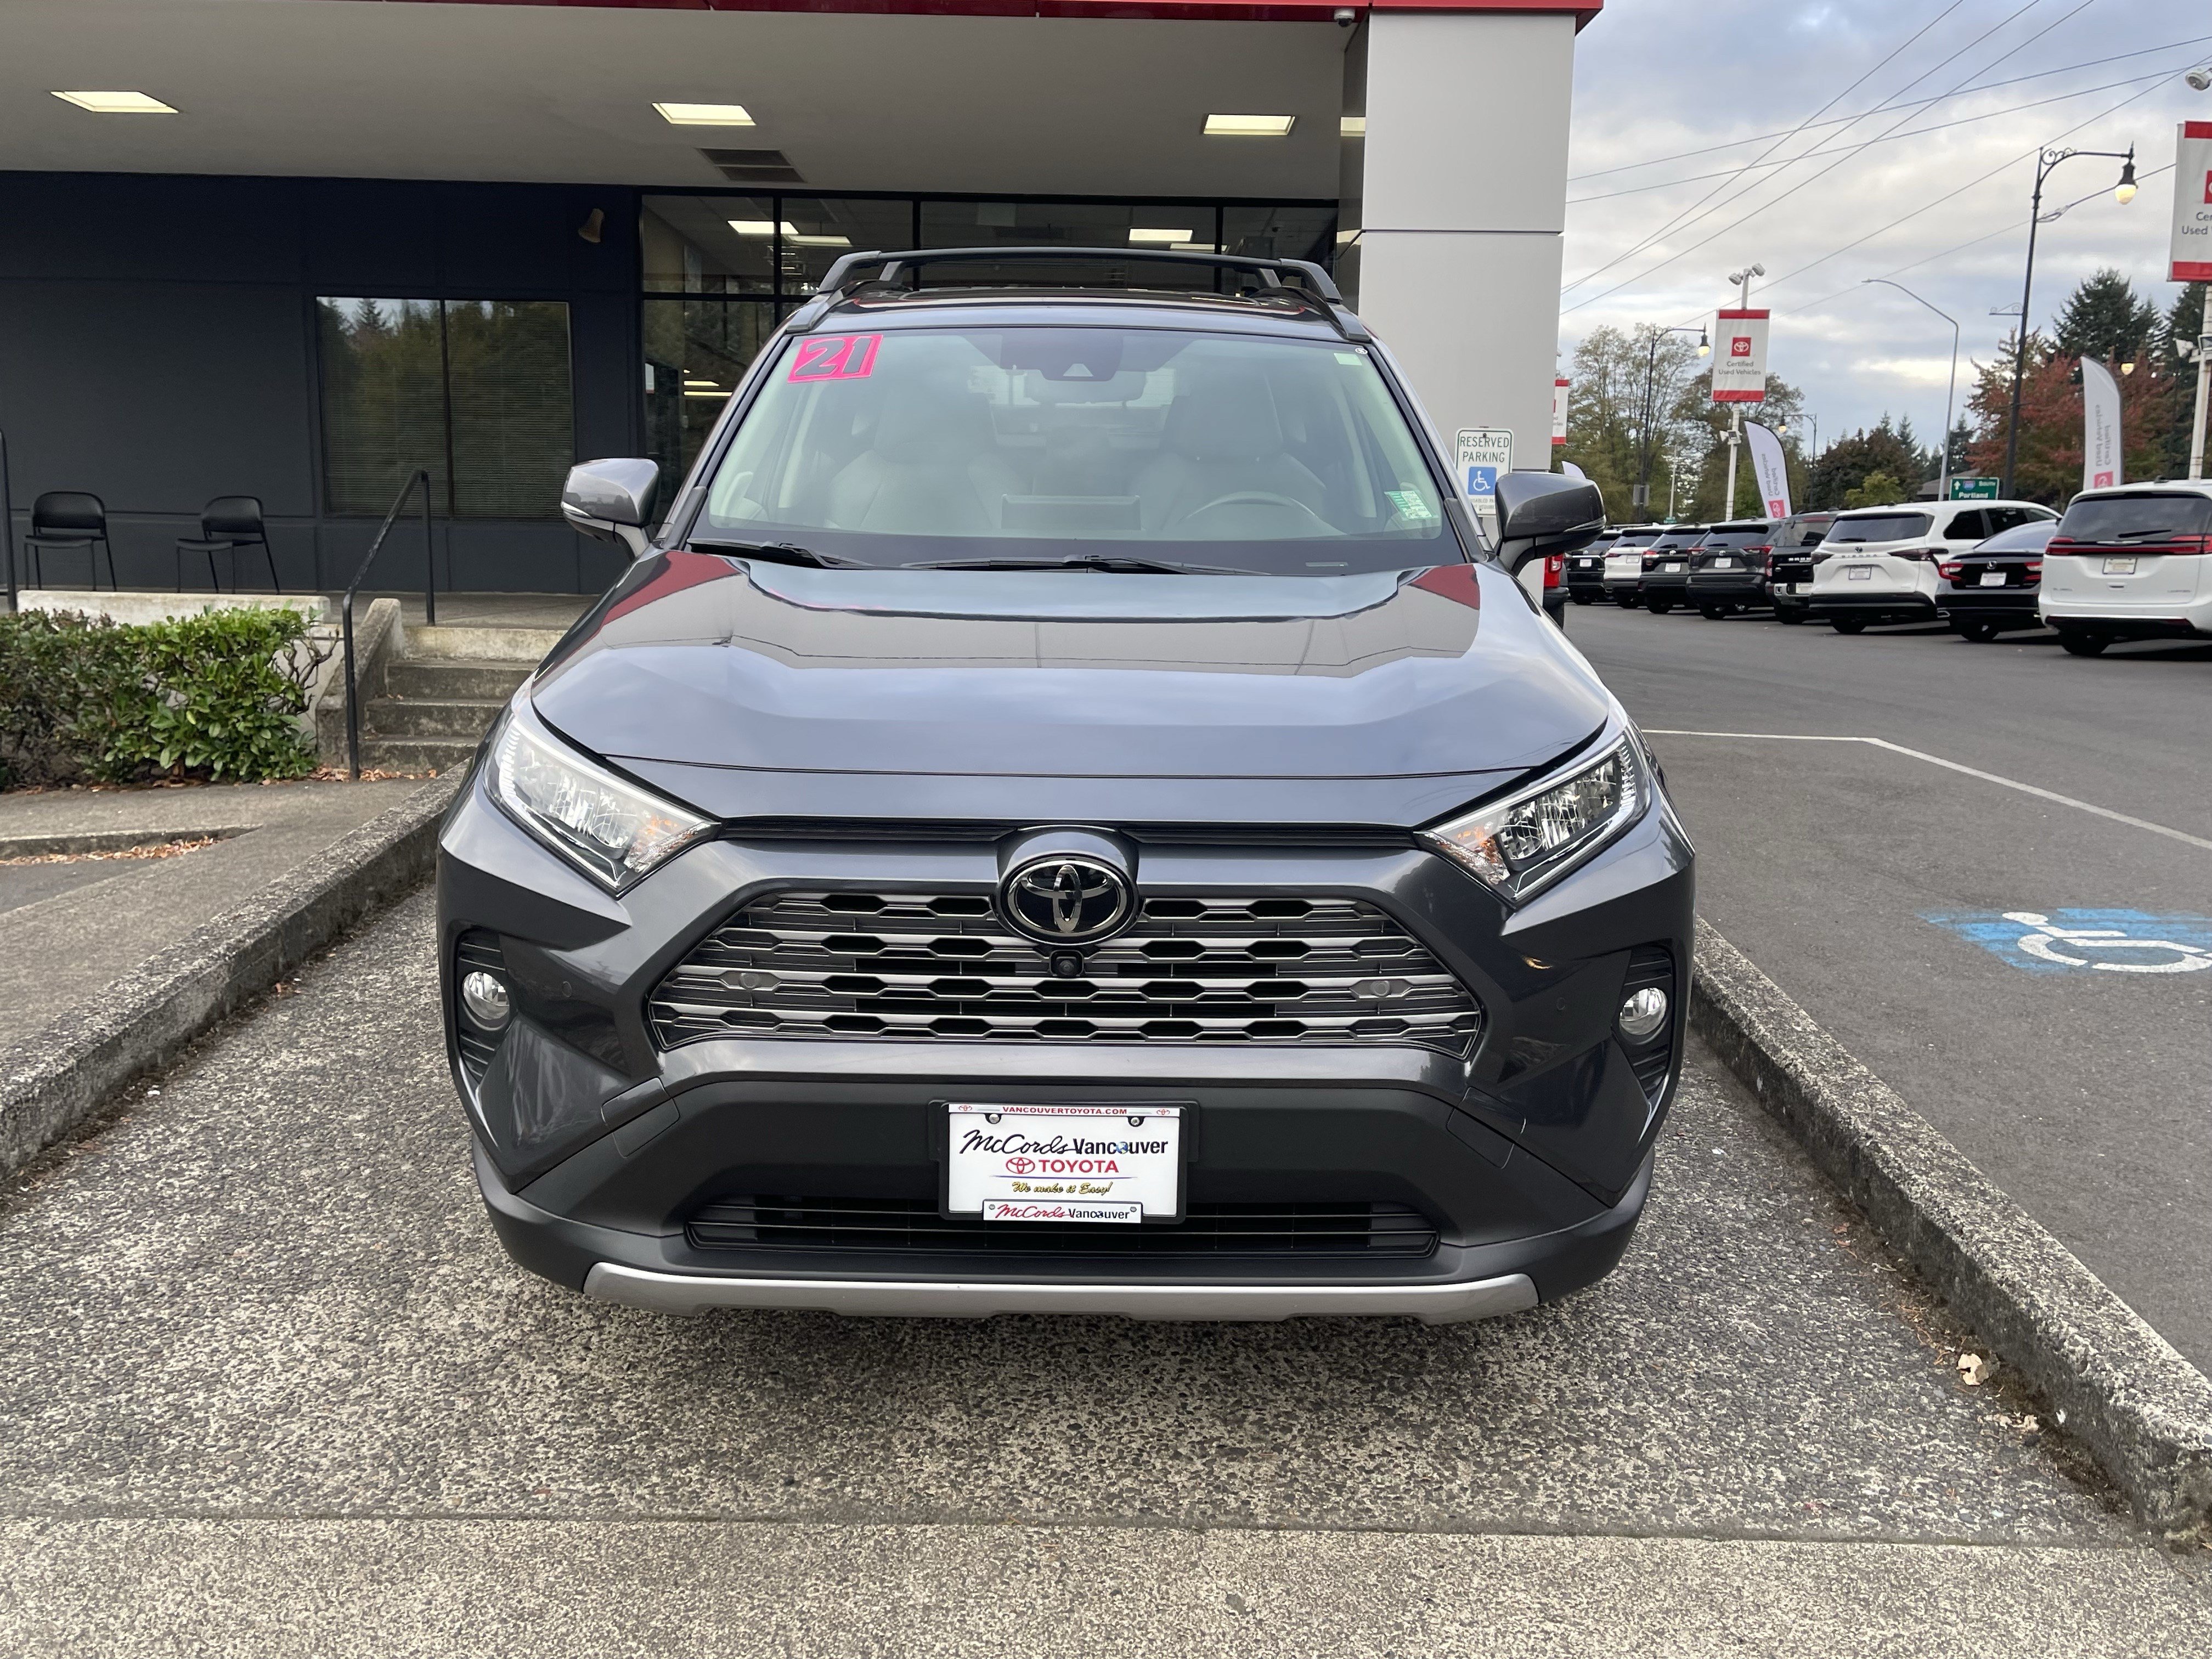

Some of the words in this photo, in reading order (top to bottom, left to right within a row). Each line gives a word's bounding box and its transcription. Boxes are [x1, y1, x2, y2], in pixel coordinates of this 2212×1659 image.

[2181, 225, 2208, 235] Used
[795, 337, 872, 376] 21
[1460, 437, 1509, 448] RESERVED
[1463, 452, 1505, 462] PARKING
[1002, 1106, 1127, 1115] VANCOUVERTOYOTA.COM
[1039, 1159, 1119, 1173] TOYOTA
[1012, 1181, 1031, 1192] We
[1034, 1183, 1064, 1193] make
[1066, 1184, 1076, 1193] it
[1079, 1181, 1114, 1196] Easy!
